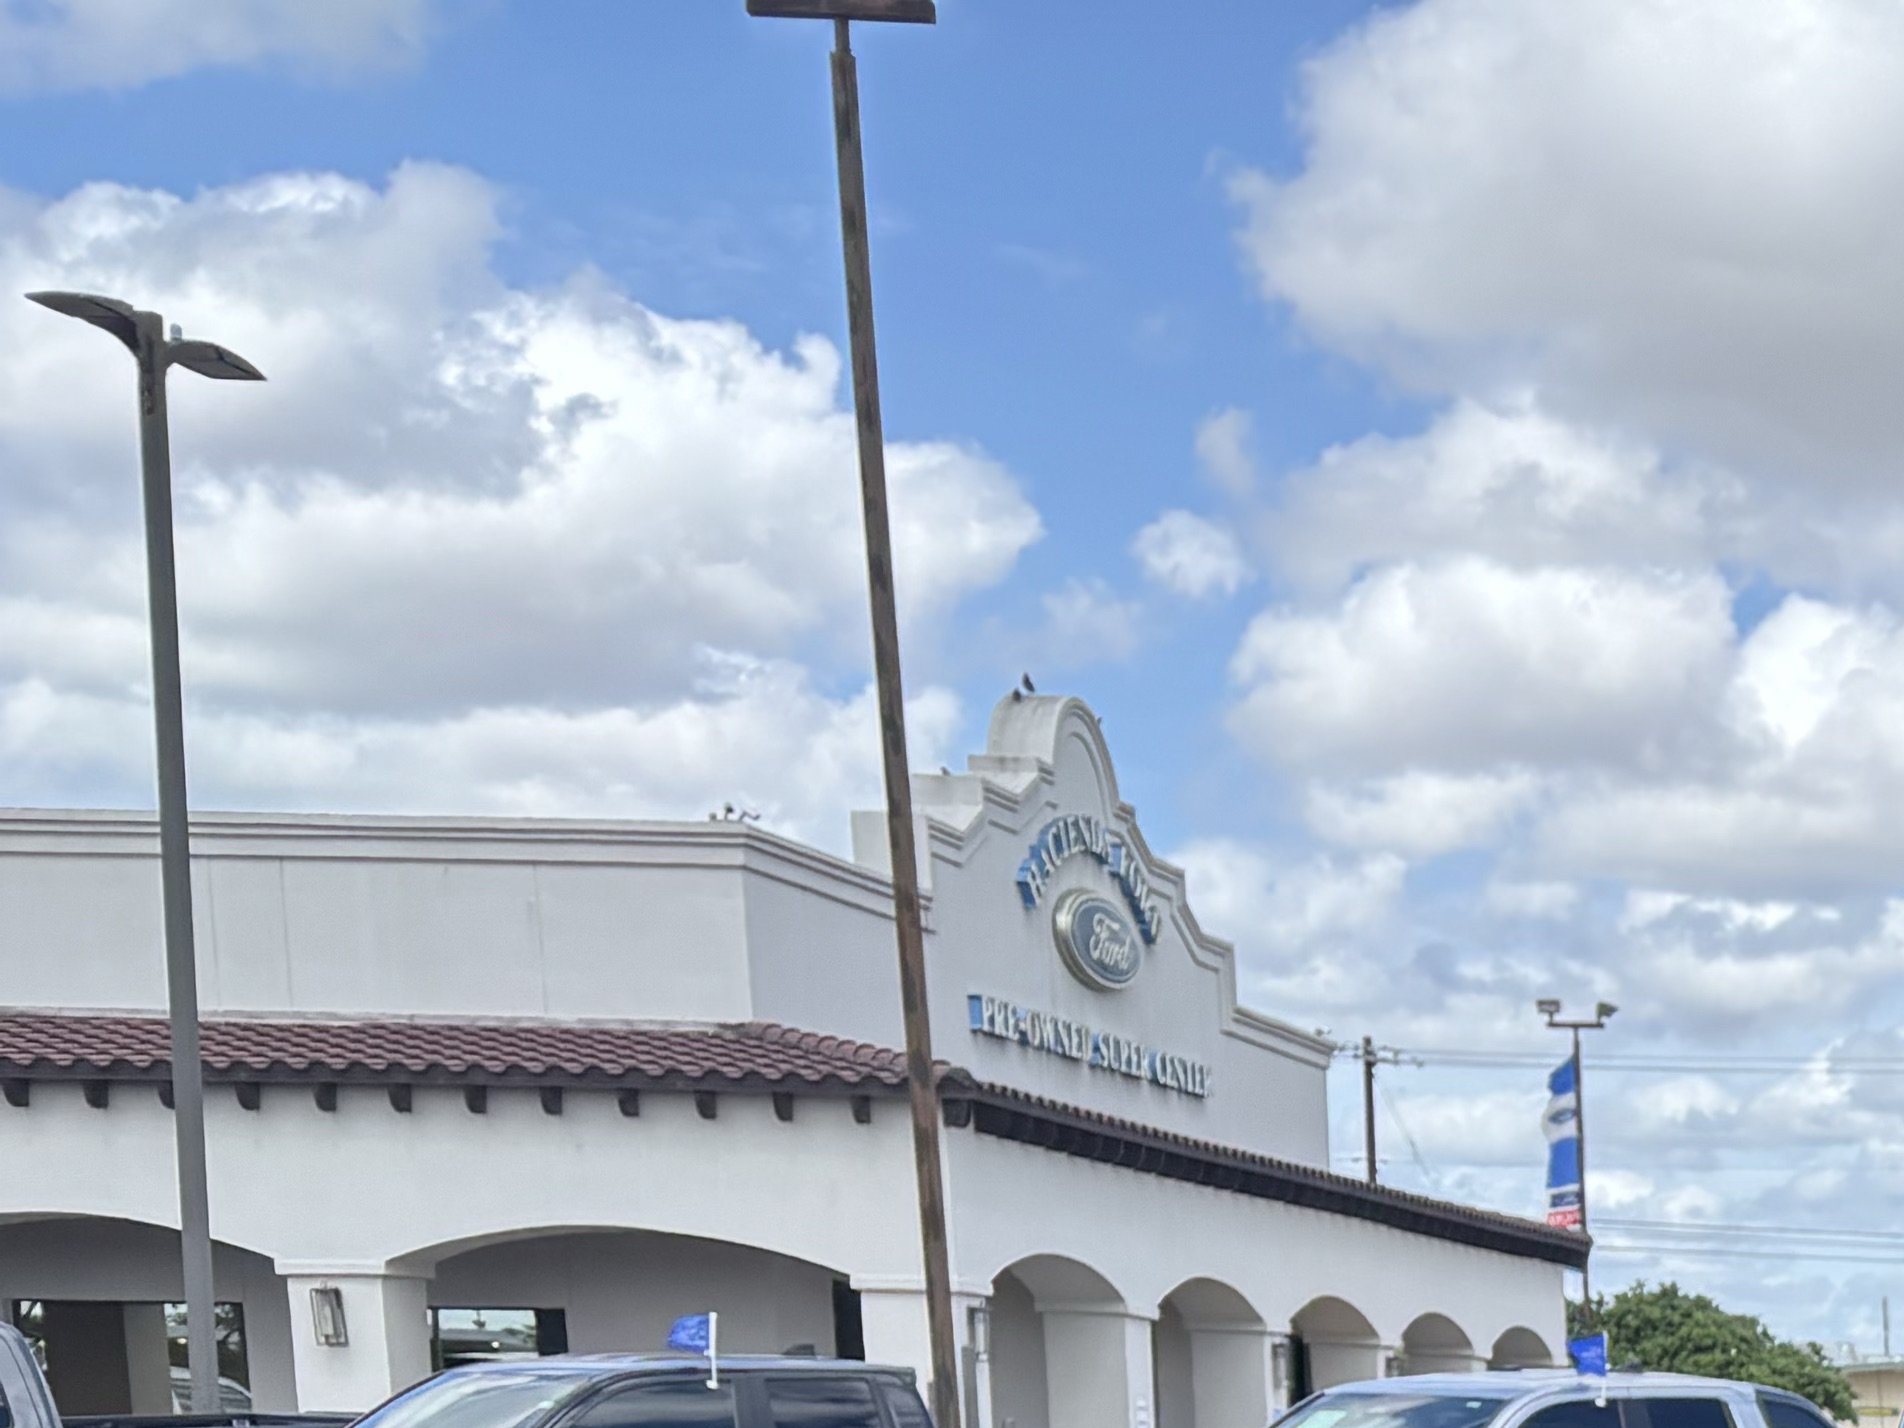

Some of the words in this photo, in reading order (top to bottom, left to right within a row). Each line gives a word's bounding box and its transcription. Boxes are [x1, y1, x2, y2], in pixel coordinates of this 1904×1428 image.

[1018, 812, 1115, 910] HACIENDA
[1112, 846, 1162, 944] FORD
[1089, 911, 1137, 970] Ford
[978, 996, 1093, 1062] PRE-OWNED
[1096, 1033, 1151, 1083] SUPER
[1154, 1050, 1213, 1099] CENTER
